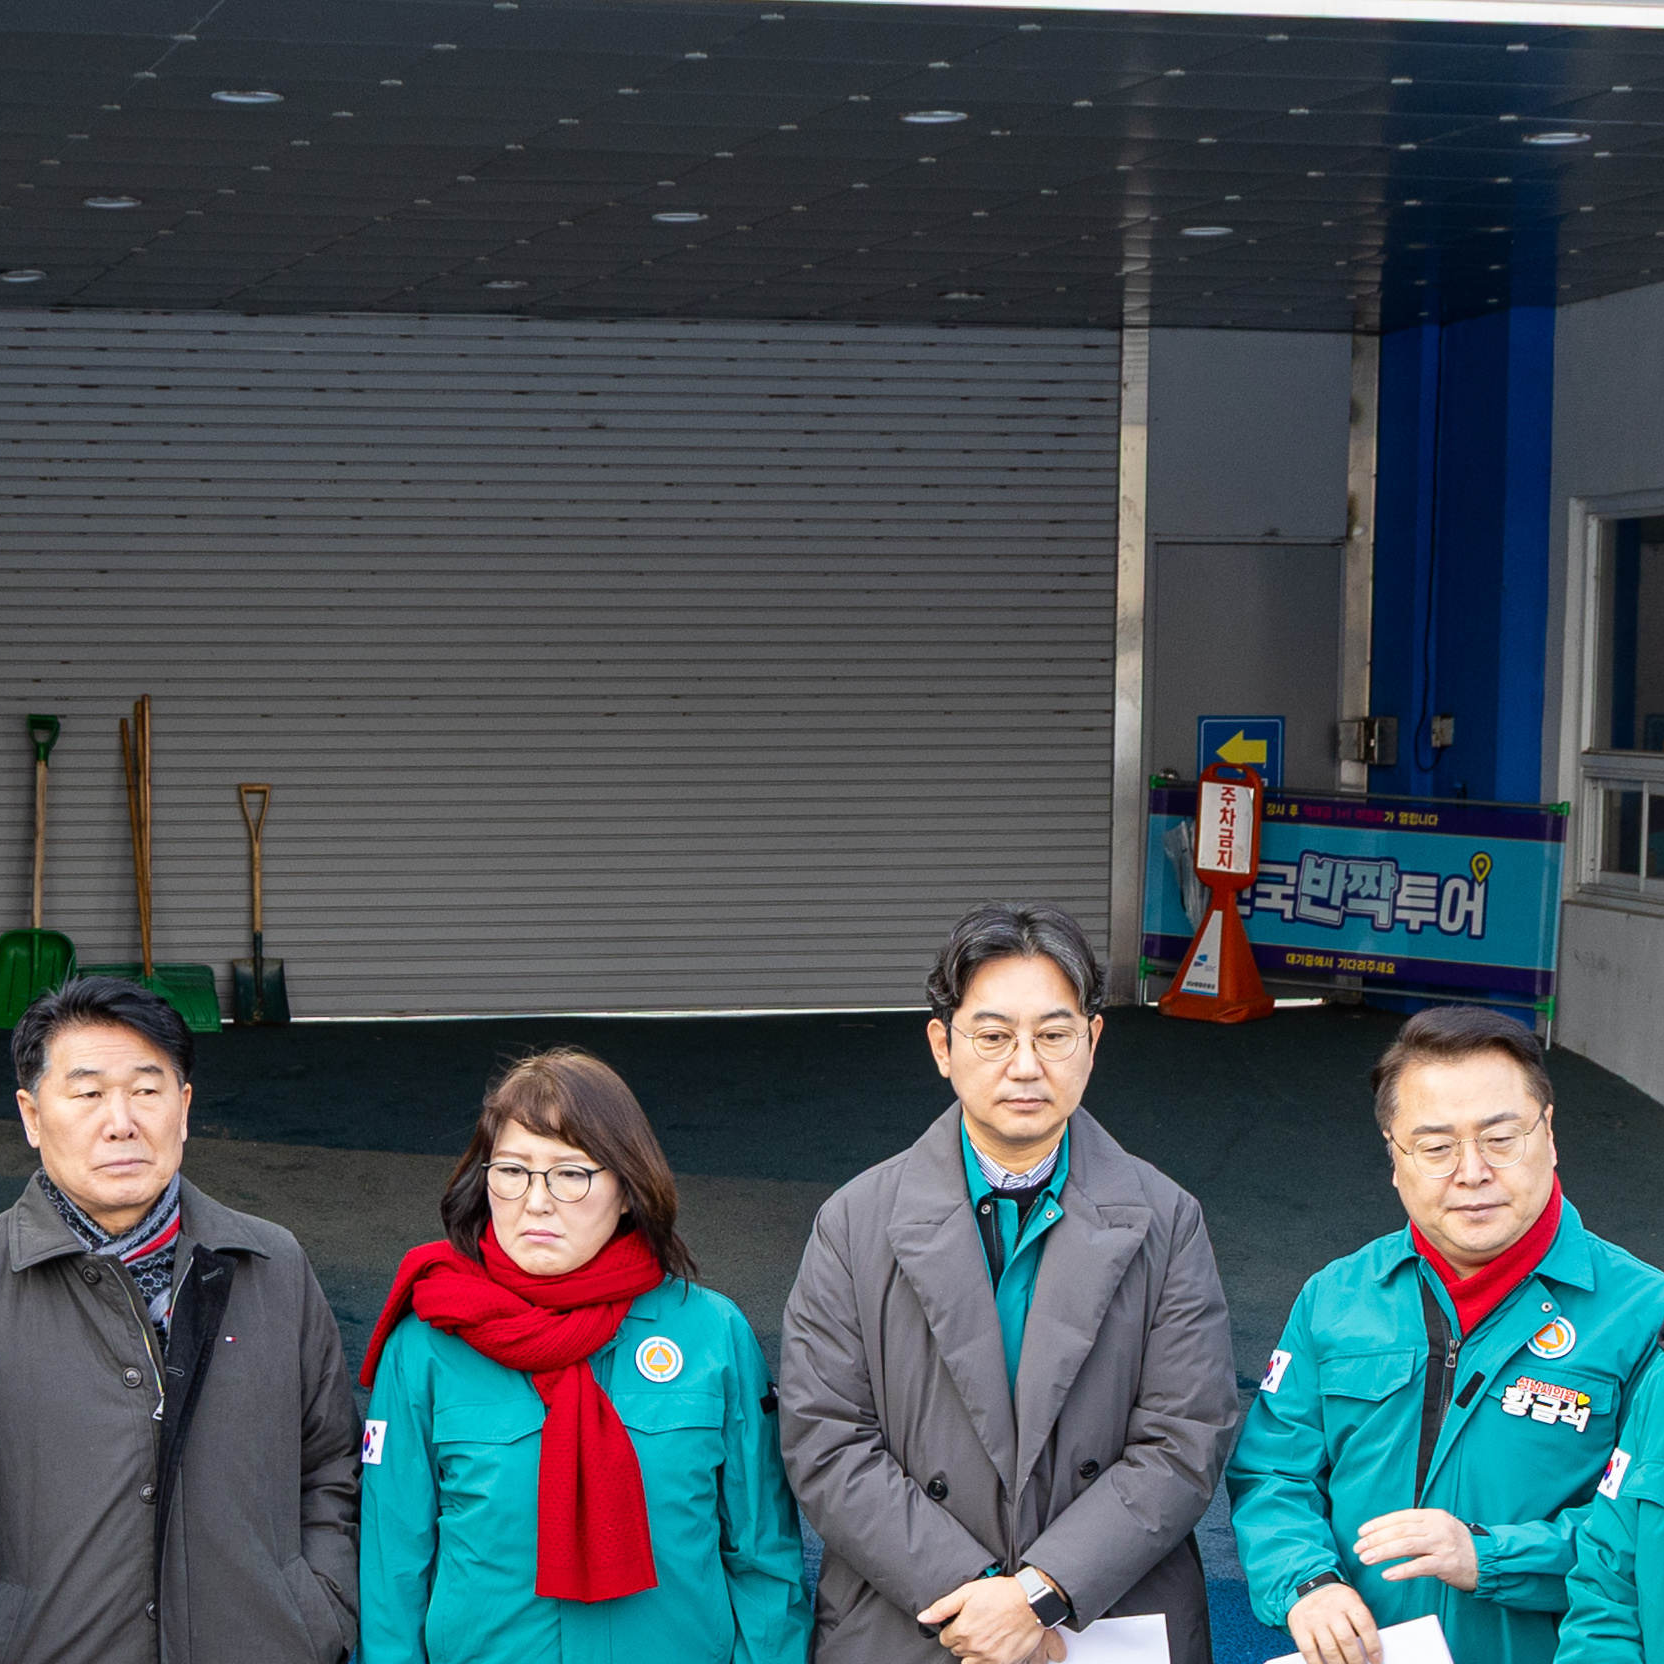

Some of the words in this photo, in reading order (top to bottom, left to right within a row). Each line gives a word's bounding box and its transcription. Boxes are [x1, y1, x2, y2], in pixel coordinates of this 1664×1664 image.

[1289, 804, 1299, 817] 후
[1217, 786, 1236, 869] 주차금지
[1338, 957, 1396, 974] 기다려주세요
[1517, 1376, 1579, 1403] 성남시의원
[1501, 1385, 1592, 1433] 황금석
